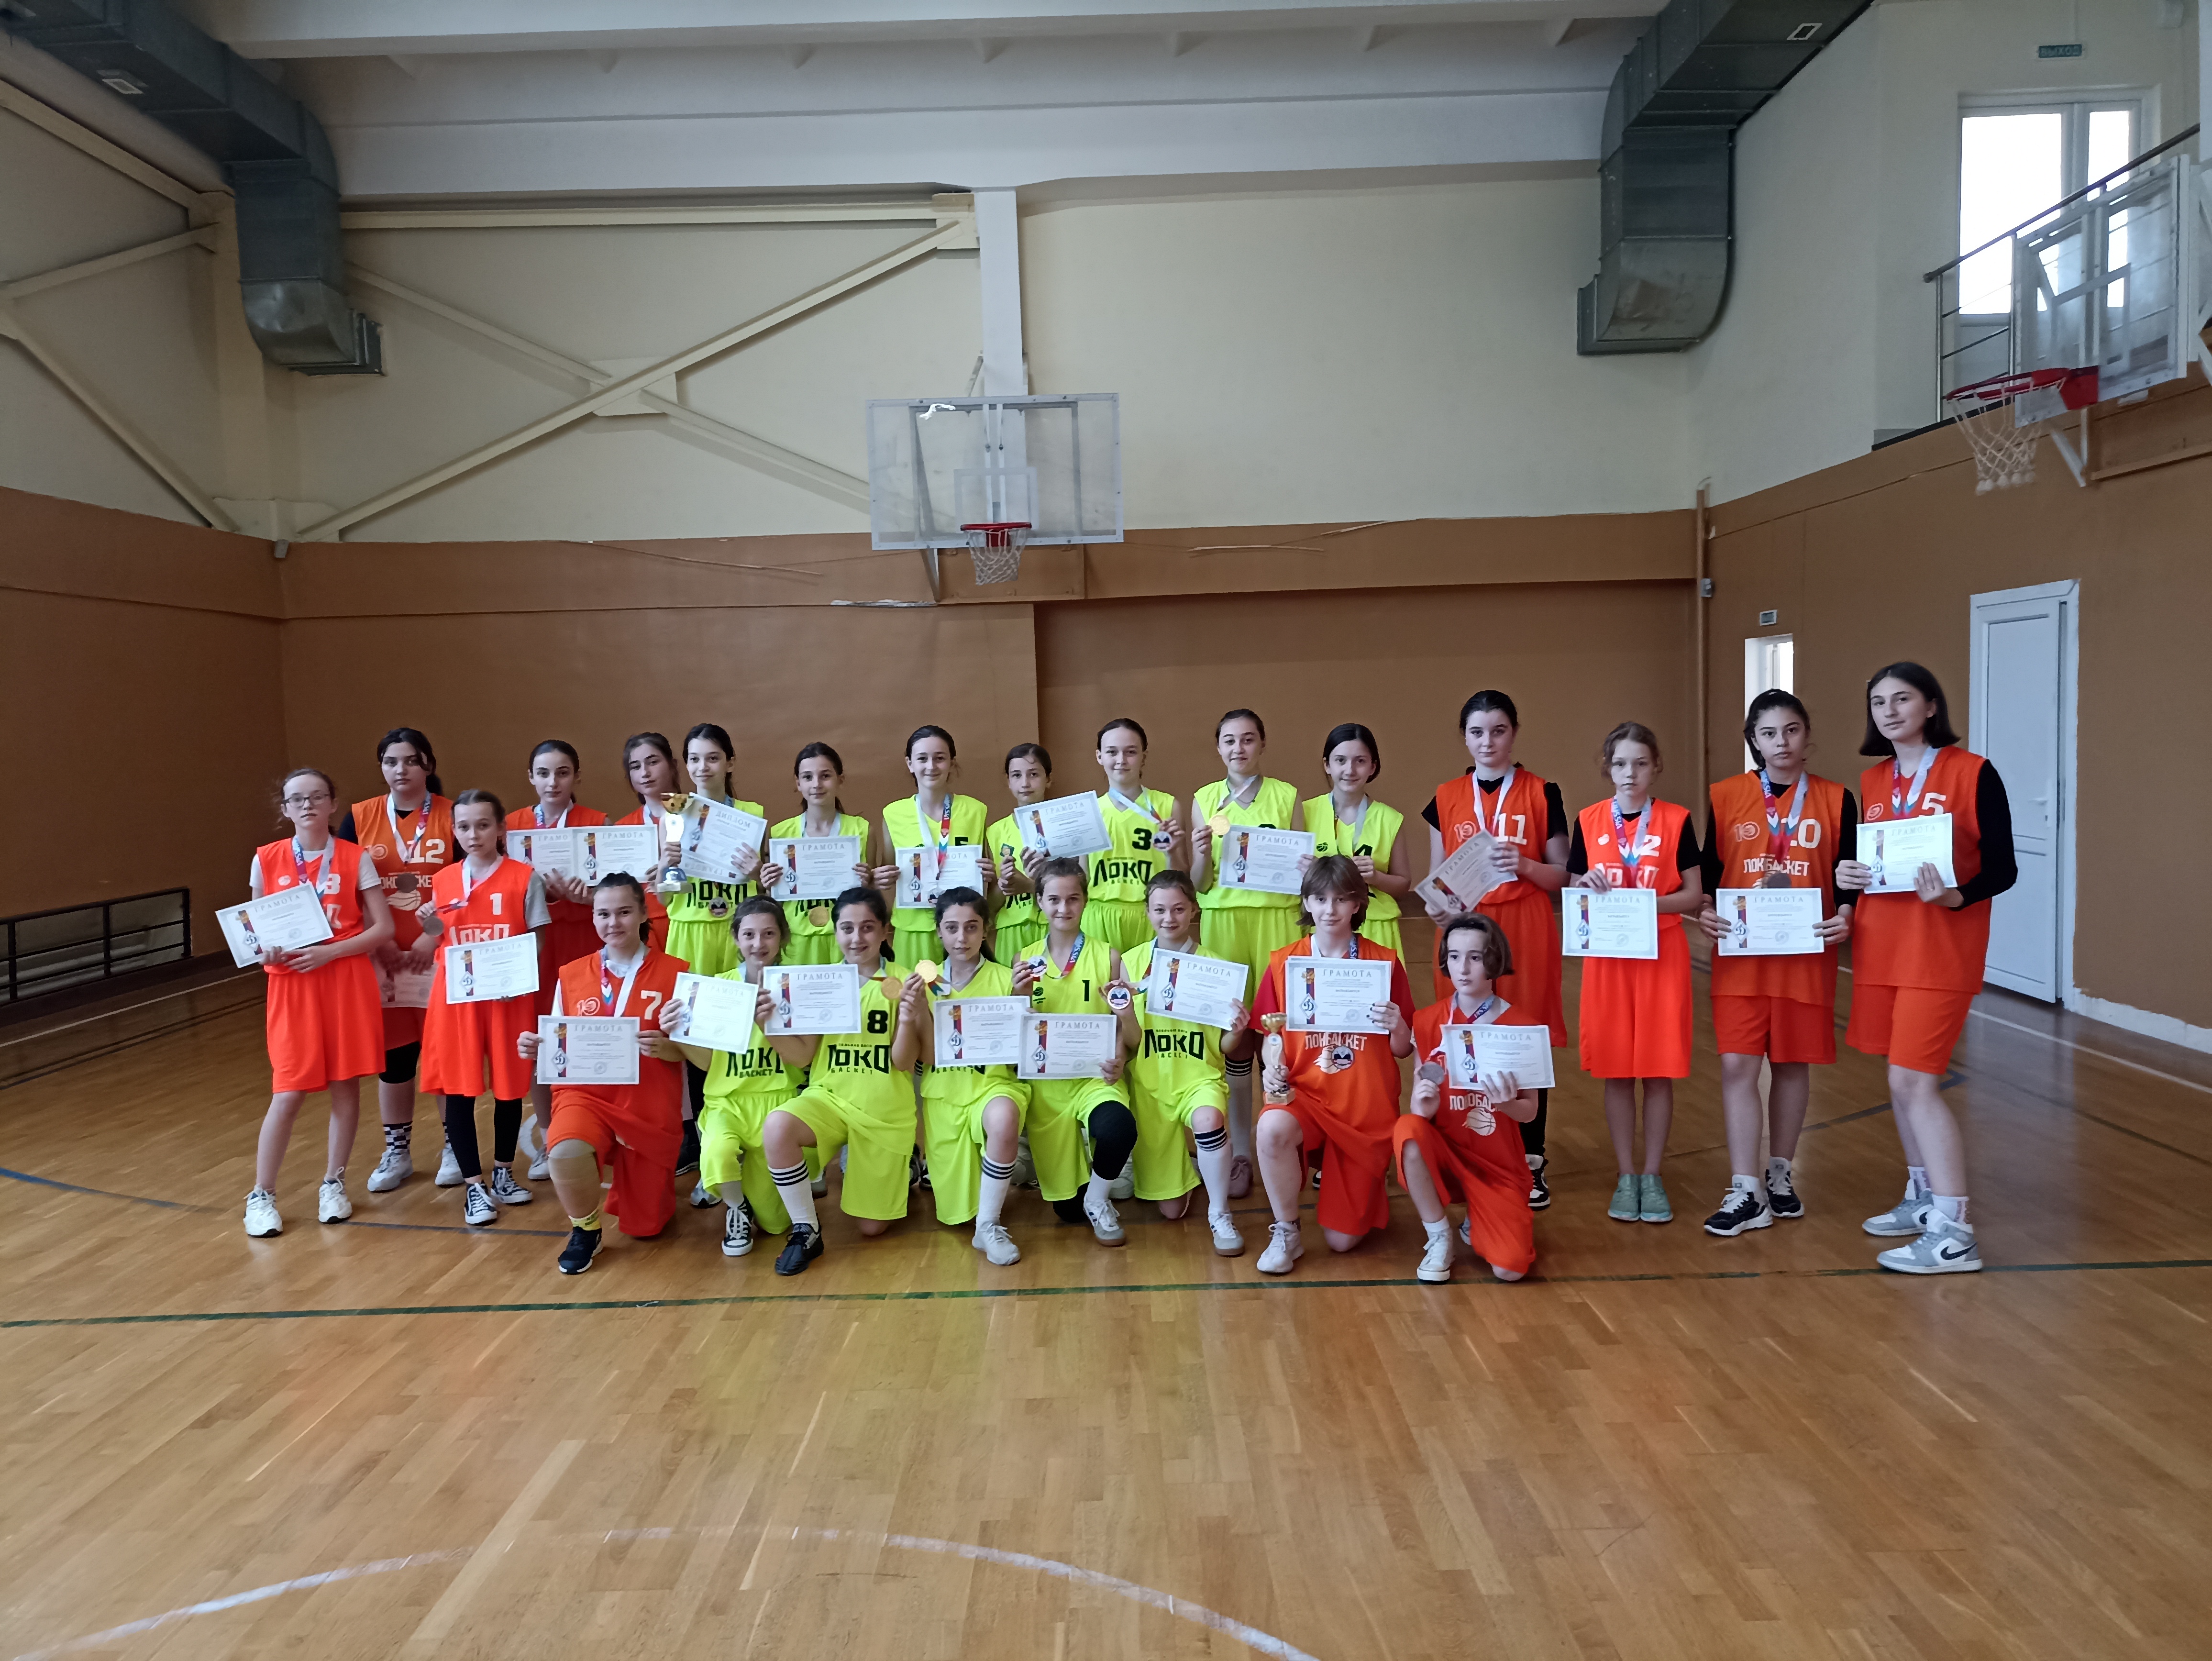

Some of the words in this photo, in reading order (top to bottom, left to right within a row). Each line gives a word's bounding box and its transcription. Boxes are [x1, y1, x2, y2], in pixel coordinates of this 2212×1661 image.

[1919, 792, 1946, 817] 5
[1132, 828, 1152, 850] 3
[1493, 813, 1527, 845] 11
[407, 839, 445, 864] 12
[1093, 859, 1153, 887] ЛОКО
[490, 893, 502, 915] 1
[797, 972, 843, 981] ГРАМОТА
[1323, 969, 1372, 977] ГРАМОТА
[1082, 979, 1090, 1001] 1
[641, 990, 662, 1020] 7
[867, 1009, 888, 1034] 8
[1144, 1029, 1204, 1060] ЛОКО
[831, 1067, 873, 1075] БАСКЕТ
